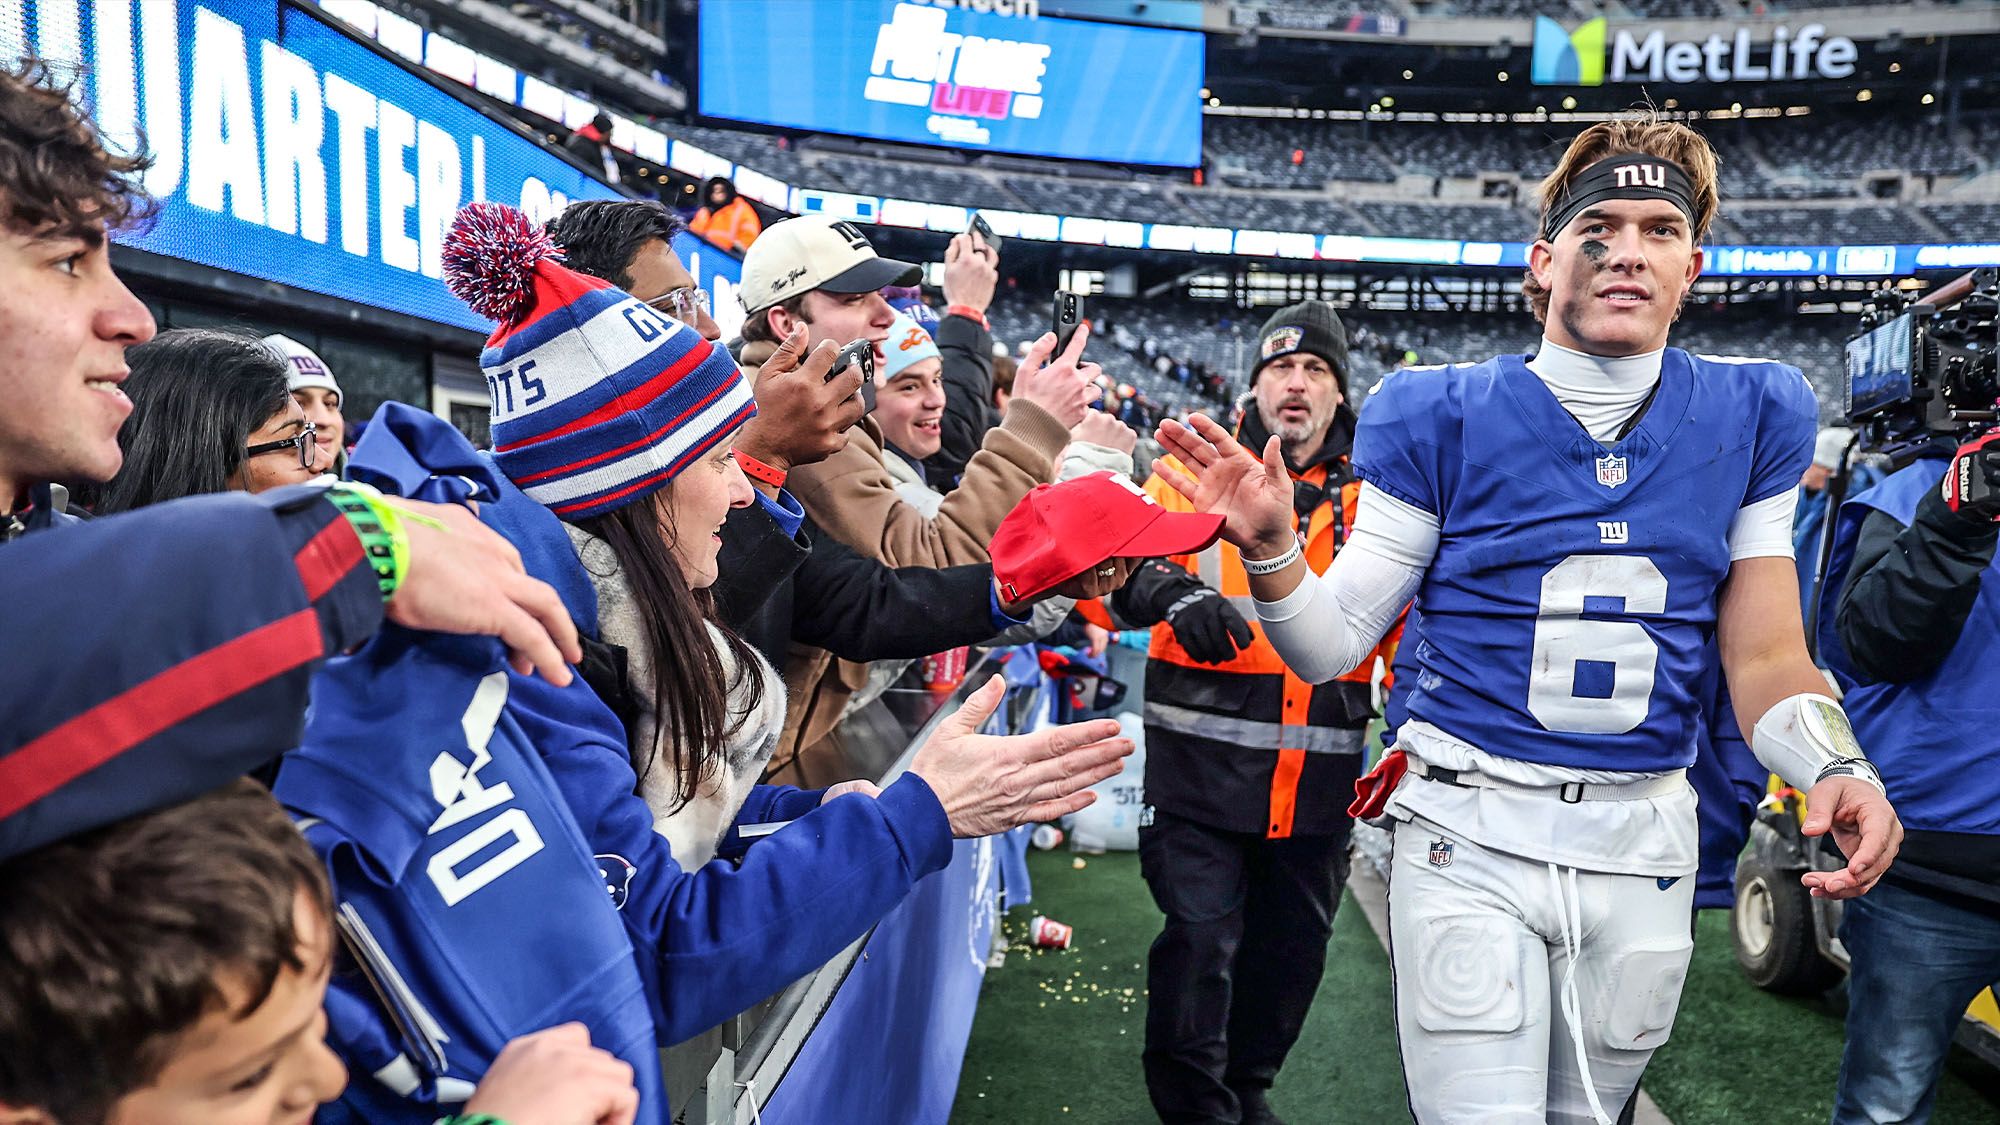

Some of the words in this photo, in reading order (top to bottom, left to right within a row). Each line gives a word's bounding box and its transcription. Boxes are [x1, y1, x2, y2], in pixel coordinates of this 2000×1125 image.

[1610, 23, 1858, 83] MetLife
[934, 83, 1009, 116] LIVE
[770, 278, 788, 293] New
[1602, 469, 1622, 482] NFL
[1527, 554, 1669, 736] 6
[1431, 851, 1449, 864] NFL
